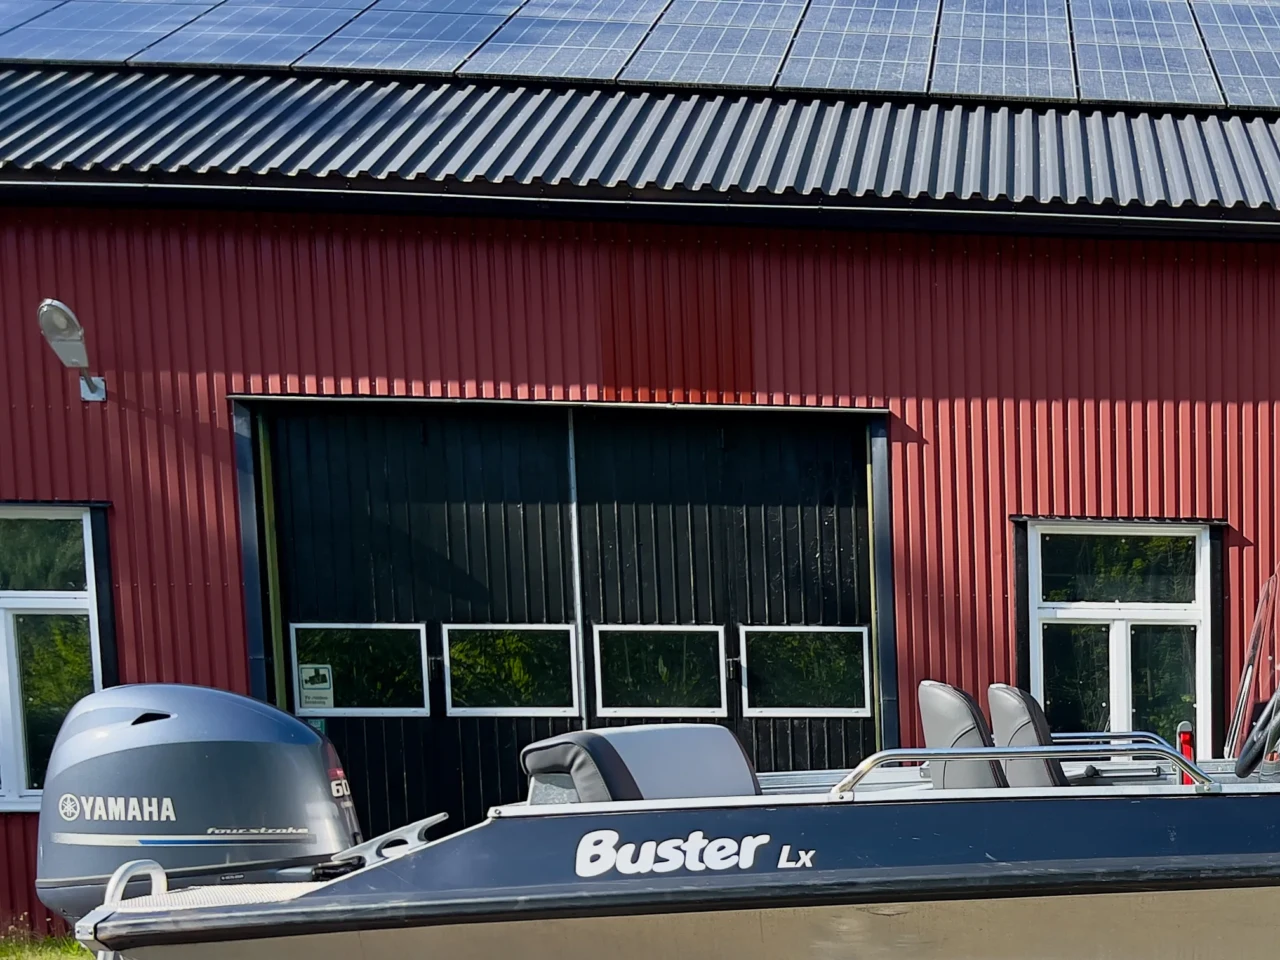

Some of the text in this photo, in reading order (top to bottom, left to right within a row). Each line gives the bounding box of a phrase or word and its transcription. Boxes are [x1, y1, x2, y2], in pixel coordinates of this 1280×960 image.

[331, 780, 350, 797] 60
[81, 796, 176, 821] YAMAHA
[575, 829, 770, 877] Buster
